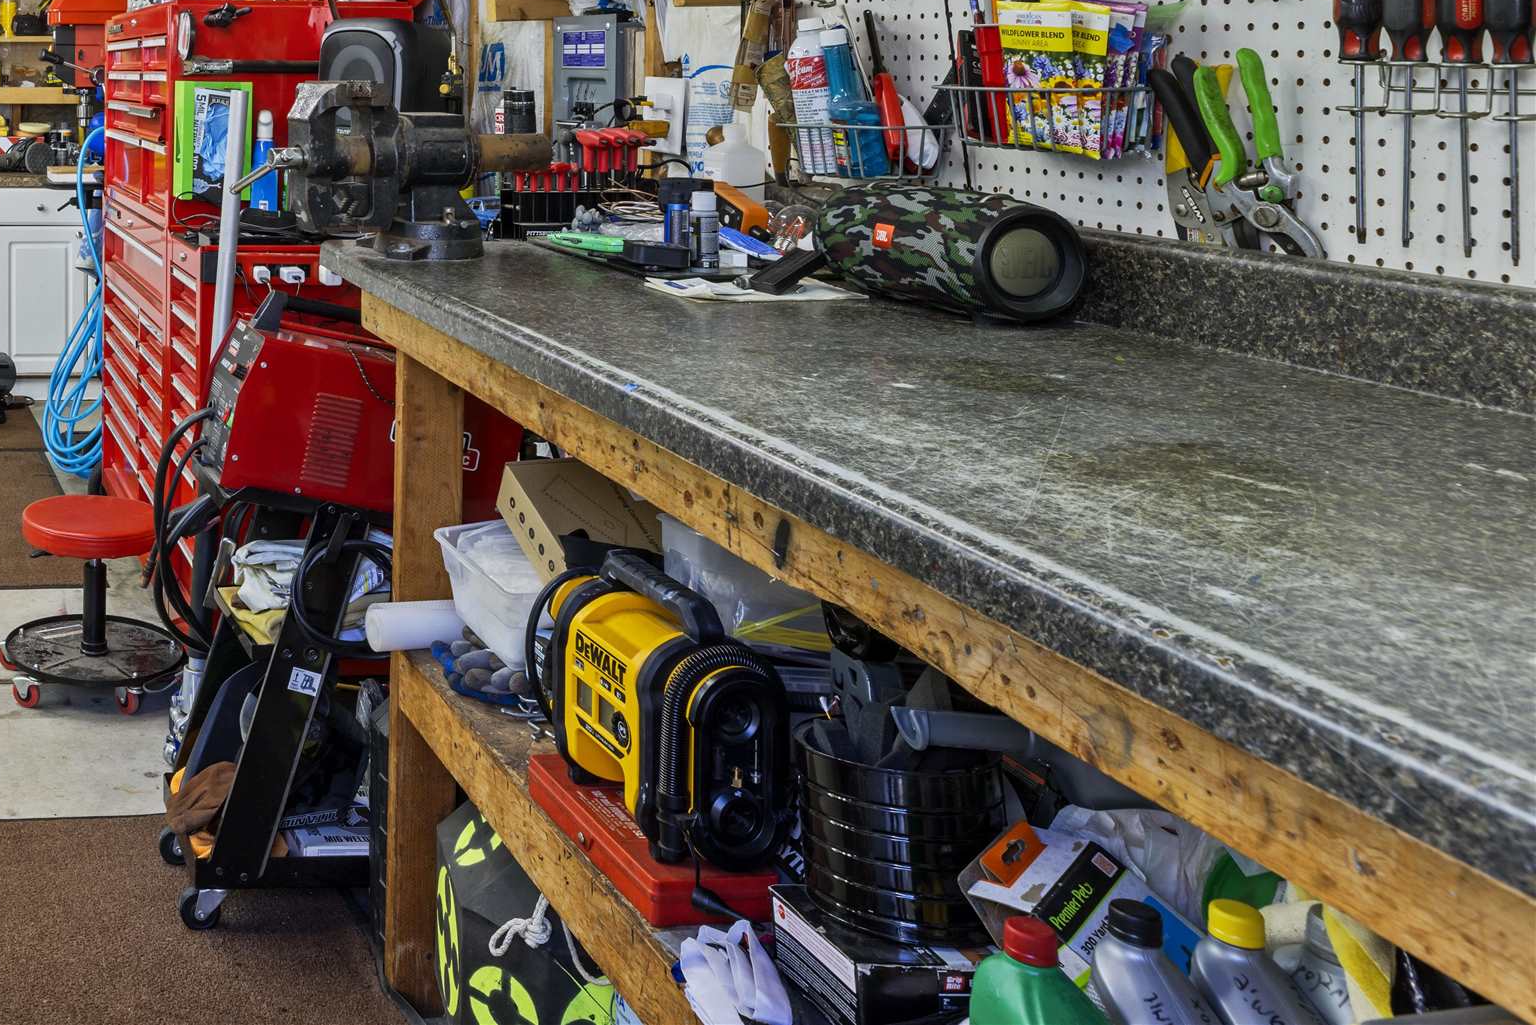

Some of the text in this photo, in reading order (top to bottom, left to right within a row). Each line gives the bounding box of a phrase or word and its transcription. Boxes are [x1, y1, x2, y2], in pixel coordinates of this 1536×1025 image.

[1001, 29, 1040, 38] WILDFLOWER
[1040, 31, 1065, 39] BLEND
[1080, 33, 1101, 42] BLEND
[1031, 40, 1049, 48] AREA
[875, 229, 888, 242] JBL
[1049, 896, 1083, 932] Premier
[1080, 936, 1097, 956] 300
